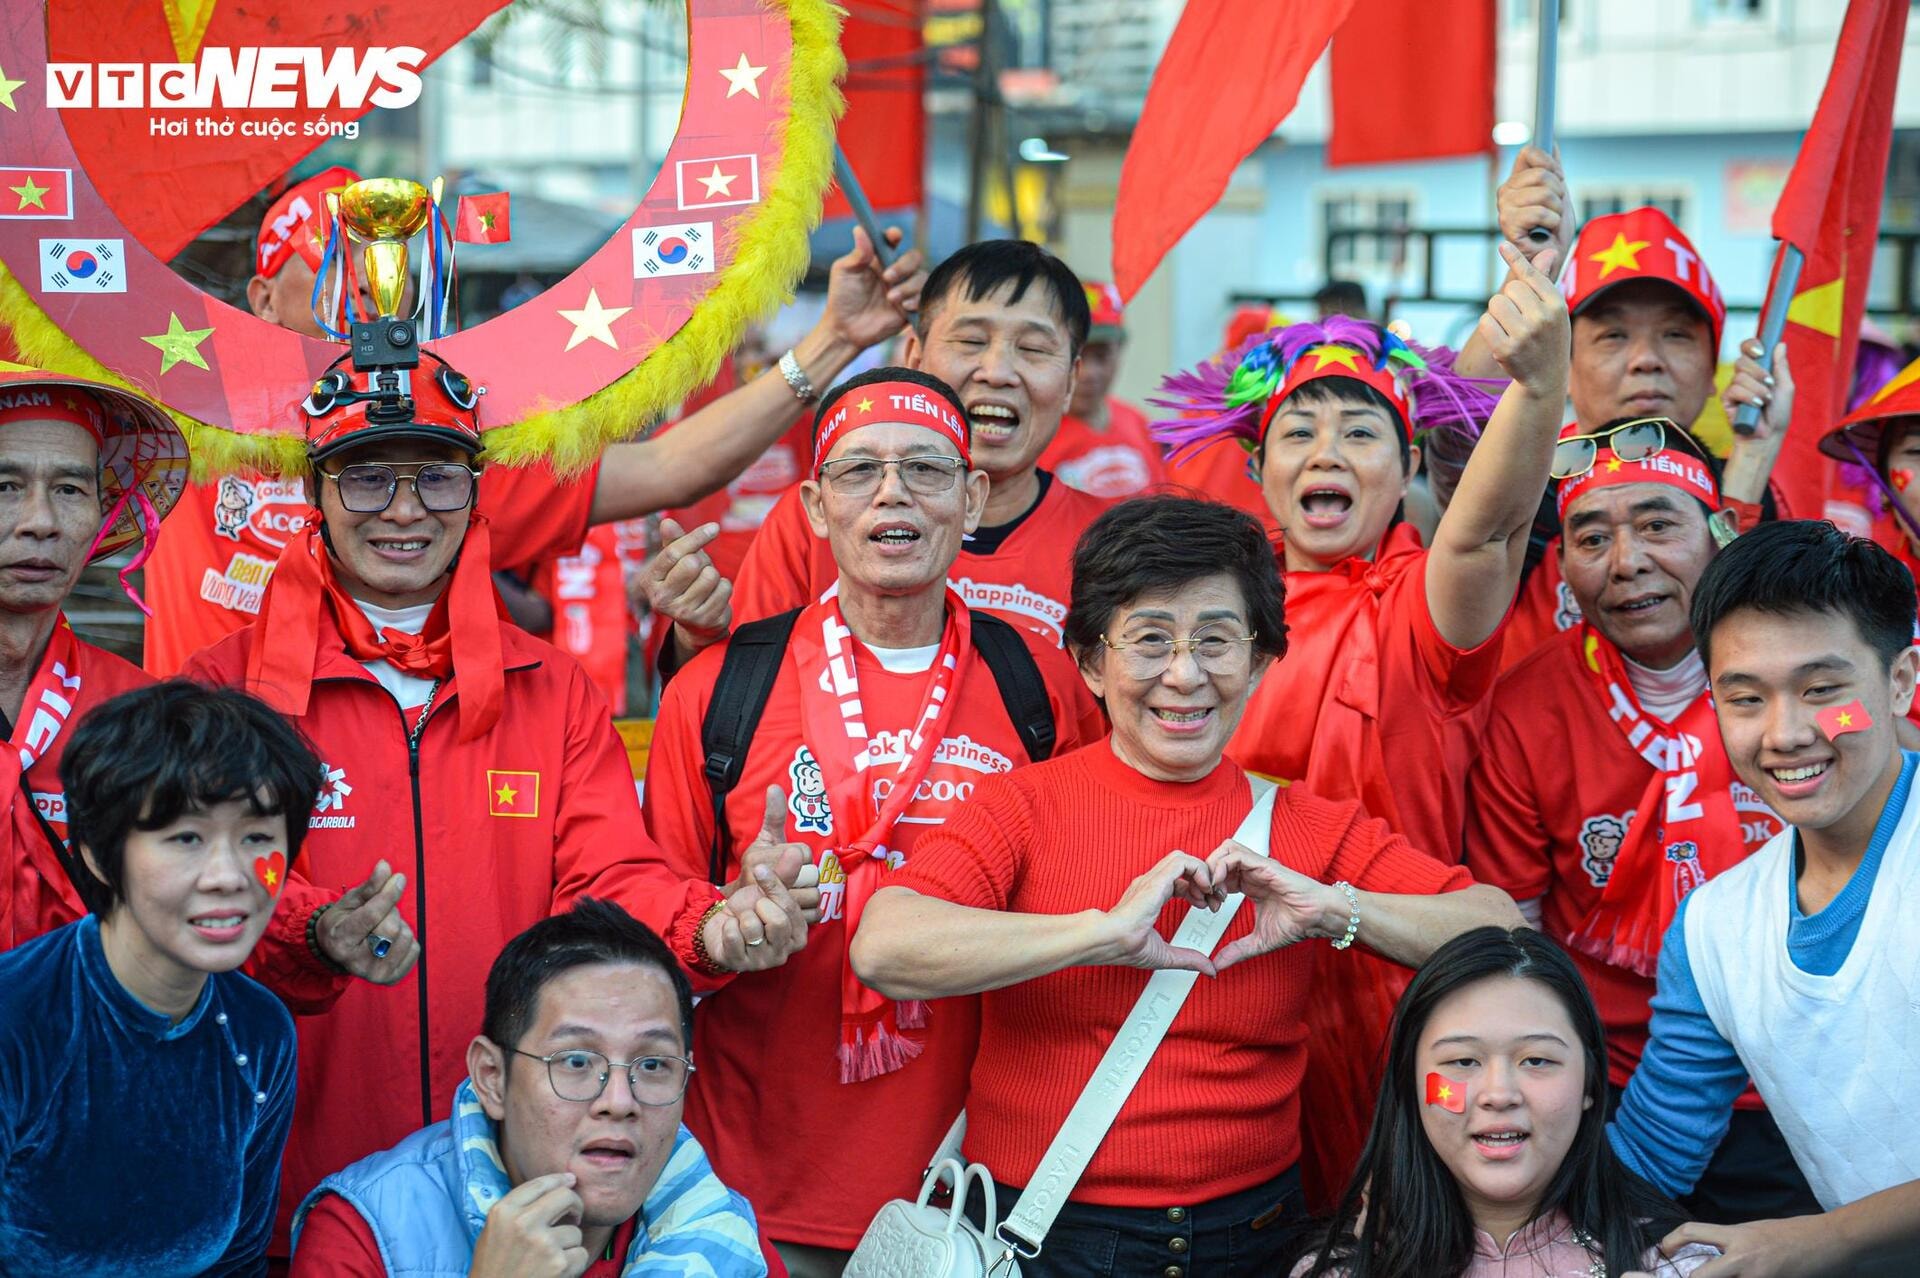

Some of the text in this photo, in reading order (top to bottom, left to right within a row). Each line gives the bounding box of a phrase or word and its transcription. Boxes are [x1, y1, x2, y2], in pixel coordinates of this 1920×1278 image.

[821, 393, 965, 446] NAM TIẾN LÊN
[1640, 455, 1684, 478] TIẾN
[1687, 467, 1714, 496] LÊN
[963, 583, 1063, 620] happiness
